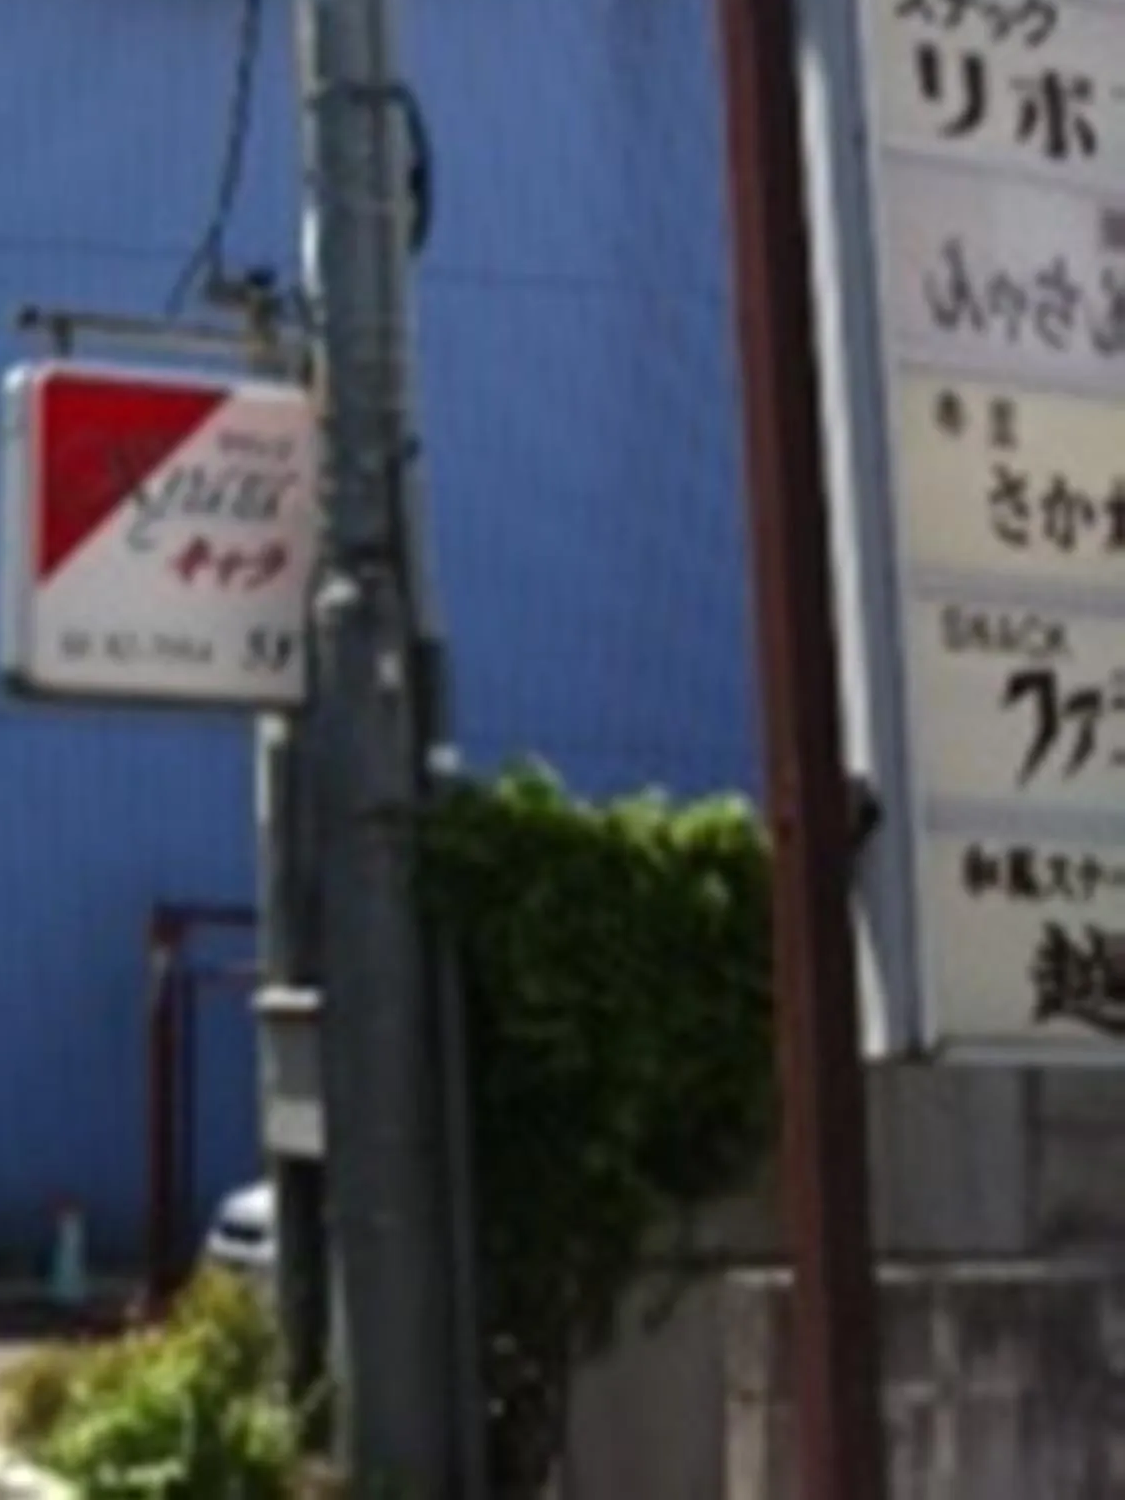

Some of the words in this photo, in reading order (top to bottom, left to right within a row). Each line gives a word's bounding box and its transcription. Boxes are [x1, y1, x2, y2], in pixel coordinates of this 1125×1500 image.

[911, 42, 1125, 162] リボ
[961, 840, 1125, 902] 和風スナ
